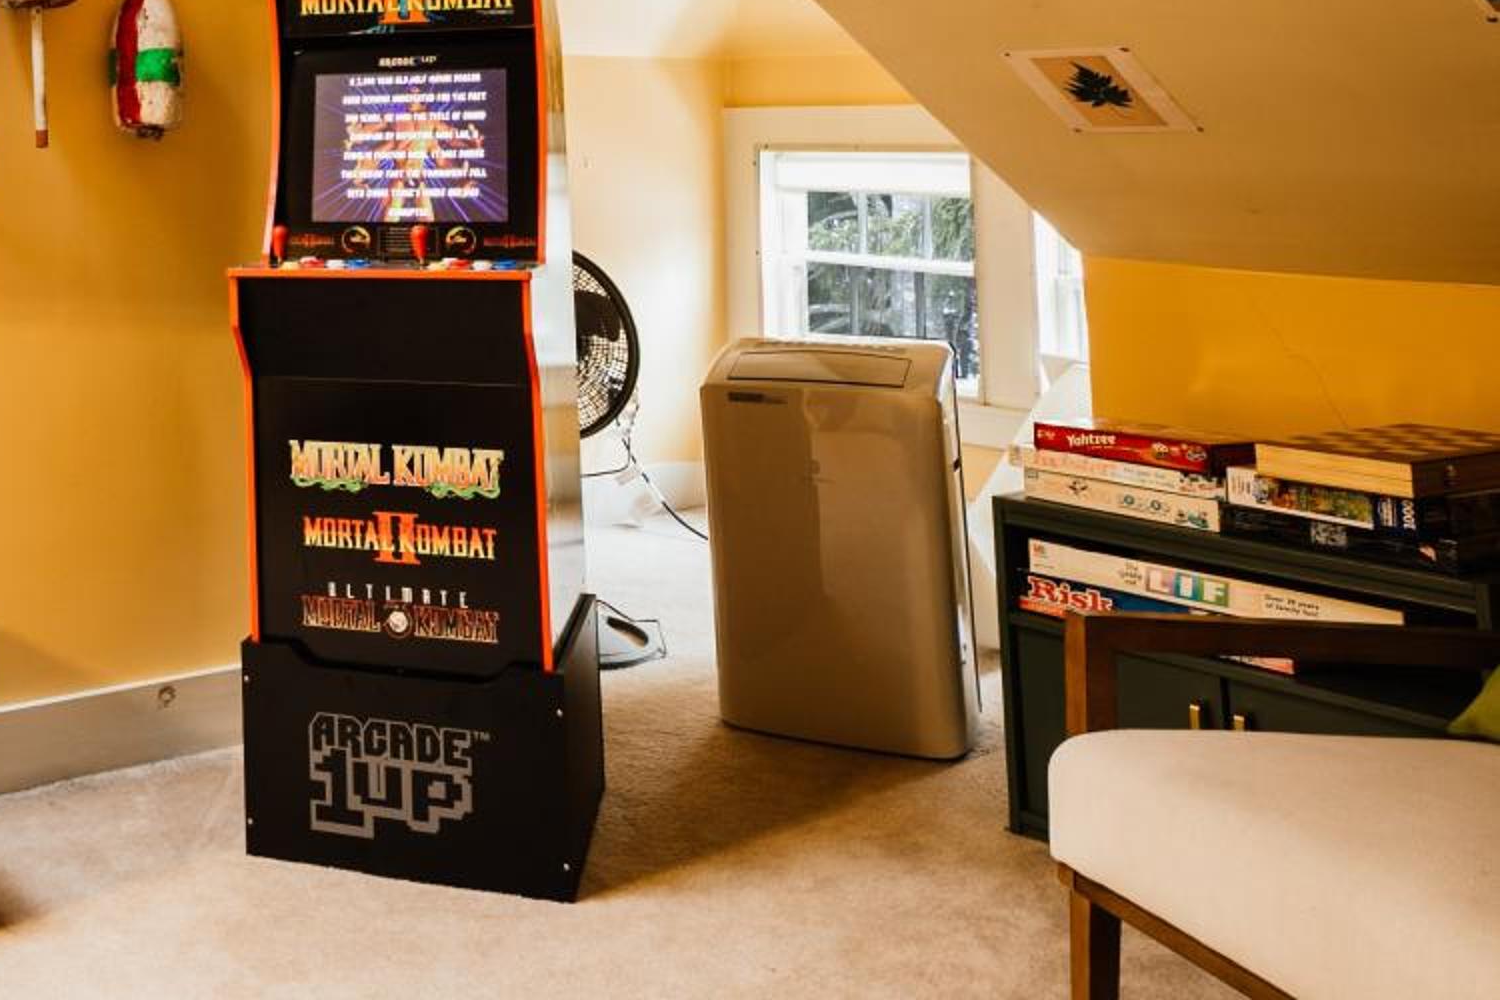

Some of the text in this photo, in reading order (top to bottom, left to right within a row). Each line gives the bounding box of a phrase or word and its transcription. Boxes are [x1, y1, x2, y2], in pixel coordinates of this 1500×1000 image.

[1066, 433, 1116, 447] Yahtzee
[289, 440, 504, 493] MORTAL KOMBAT
[304, 516, 396, 551] MORTAL
[399, 520, 498, 560] KOMBAT
[328, 581, 468, 608] ULTIMATE
[1028, 575, 1113, 615] Risk
[302, 596, 381, 632] MORTAL
[414, 604, 499, 643] KOMBAT
[309, 712, 470, 770] ARCADE
[310, 748, 473, 839] 1UP
